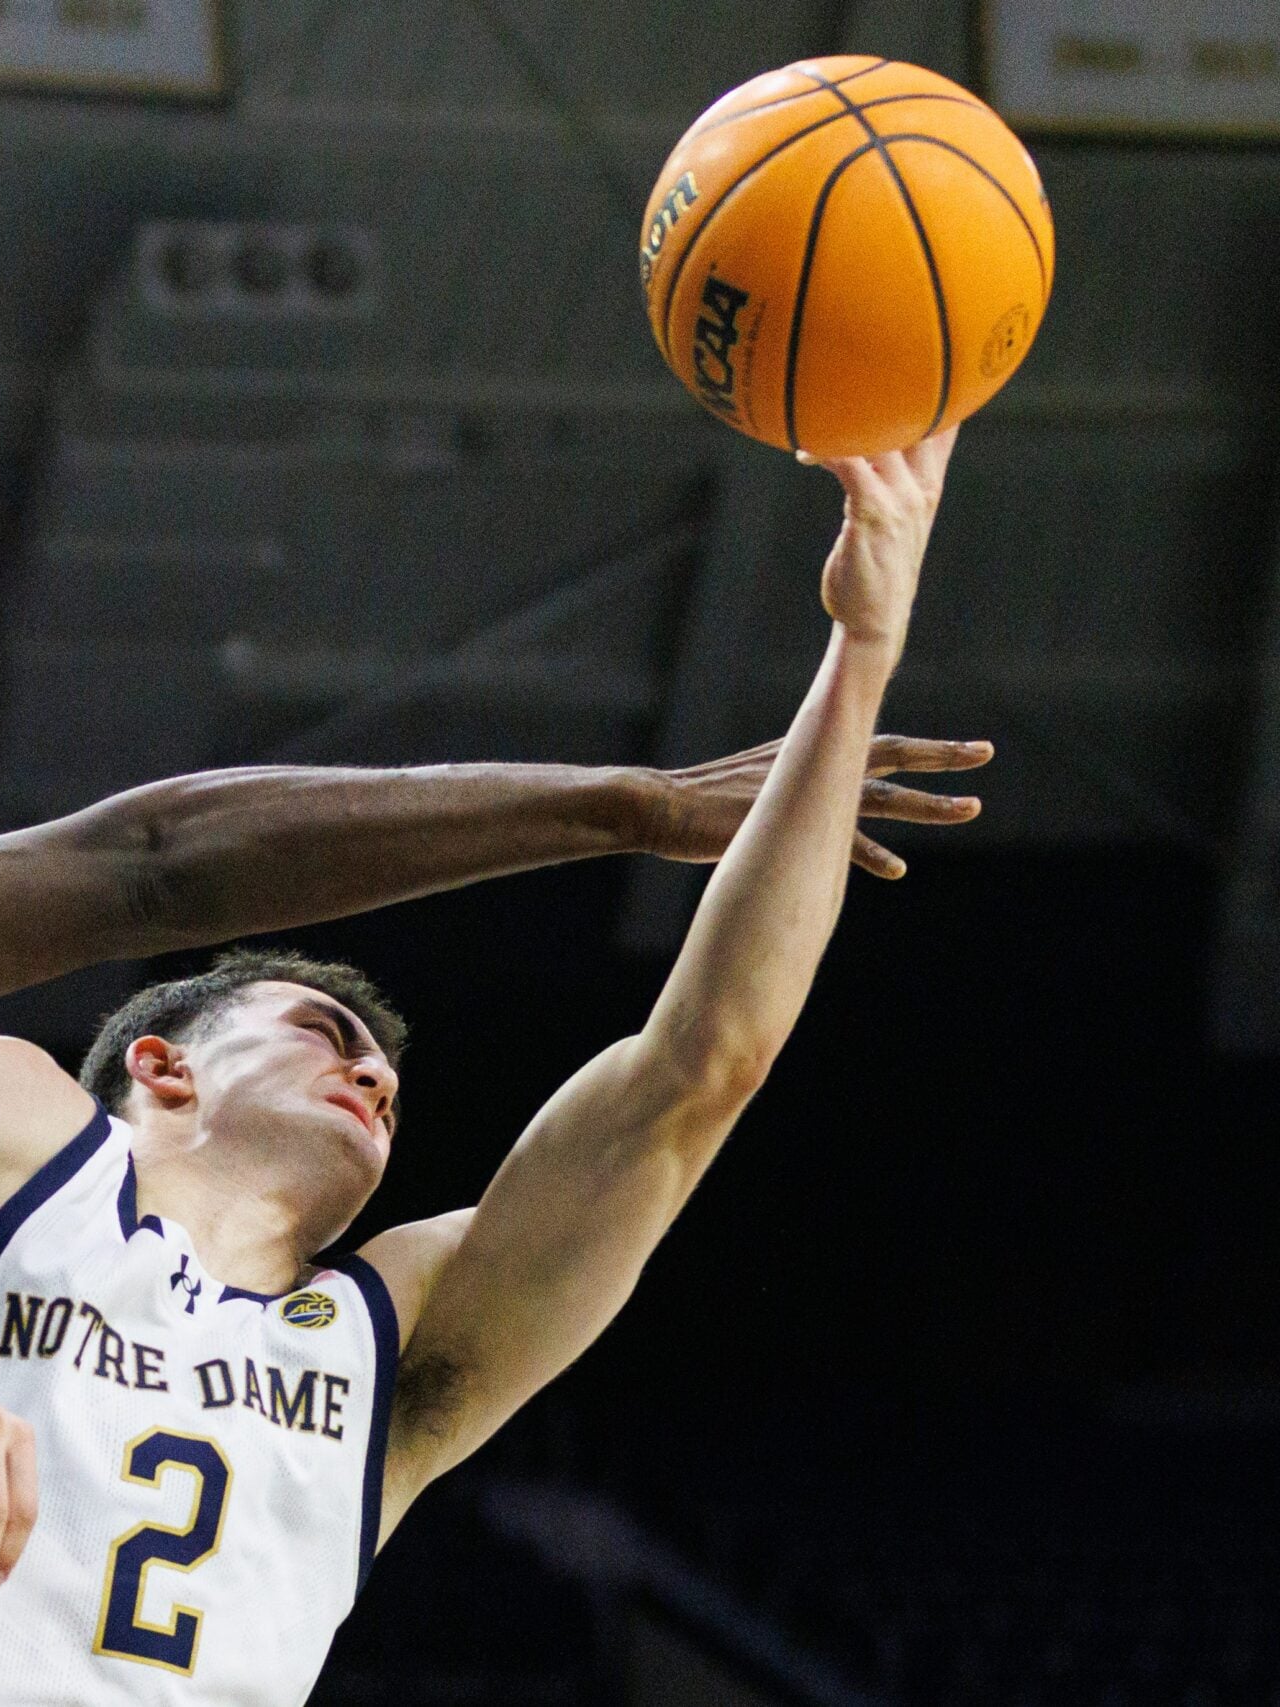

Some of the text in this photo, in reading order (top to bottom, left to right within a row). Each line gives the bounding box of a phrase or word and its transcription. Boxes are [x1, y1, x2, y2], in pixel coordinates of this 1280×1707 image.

[288, 1300, 336, 1316] ACC
[193, 1357, 351, 1441] DAME
[92, 1424, 235, 1678] 2
